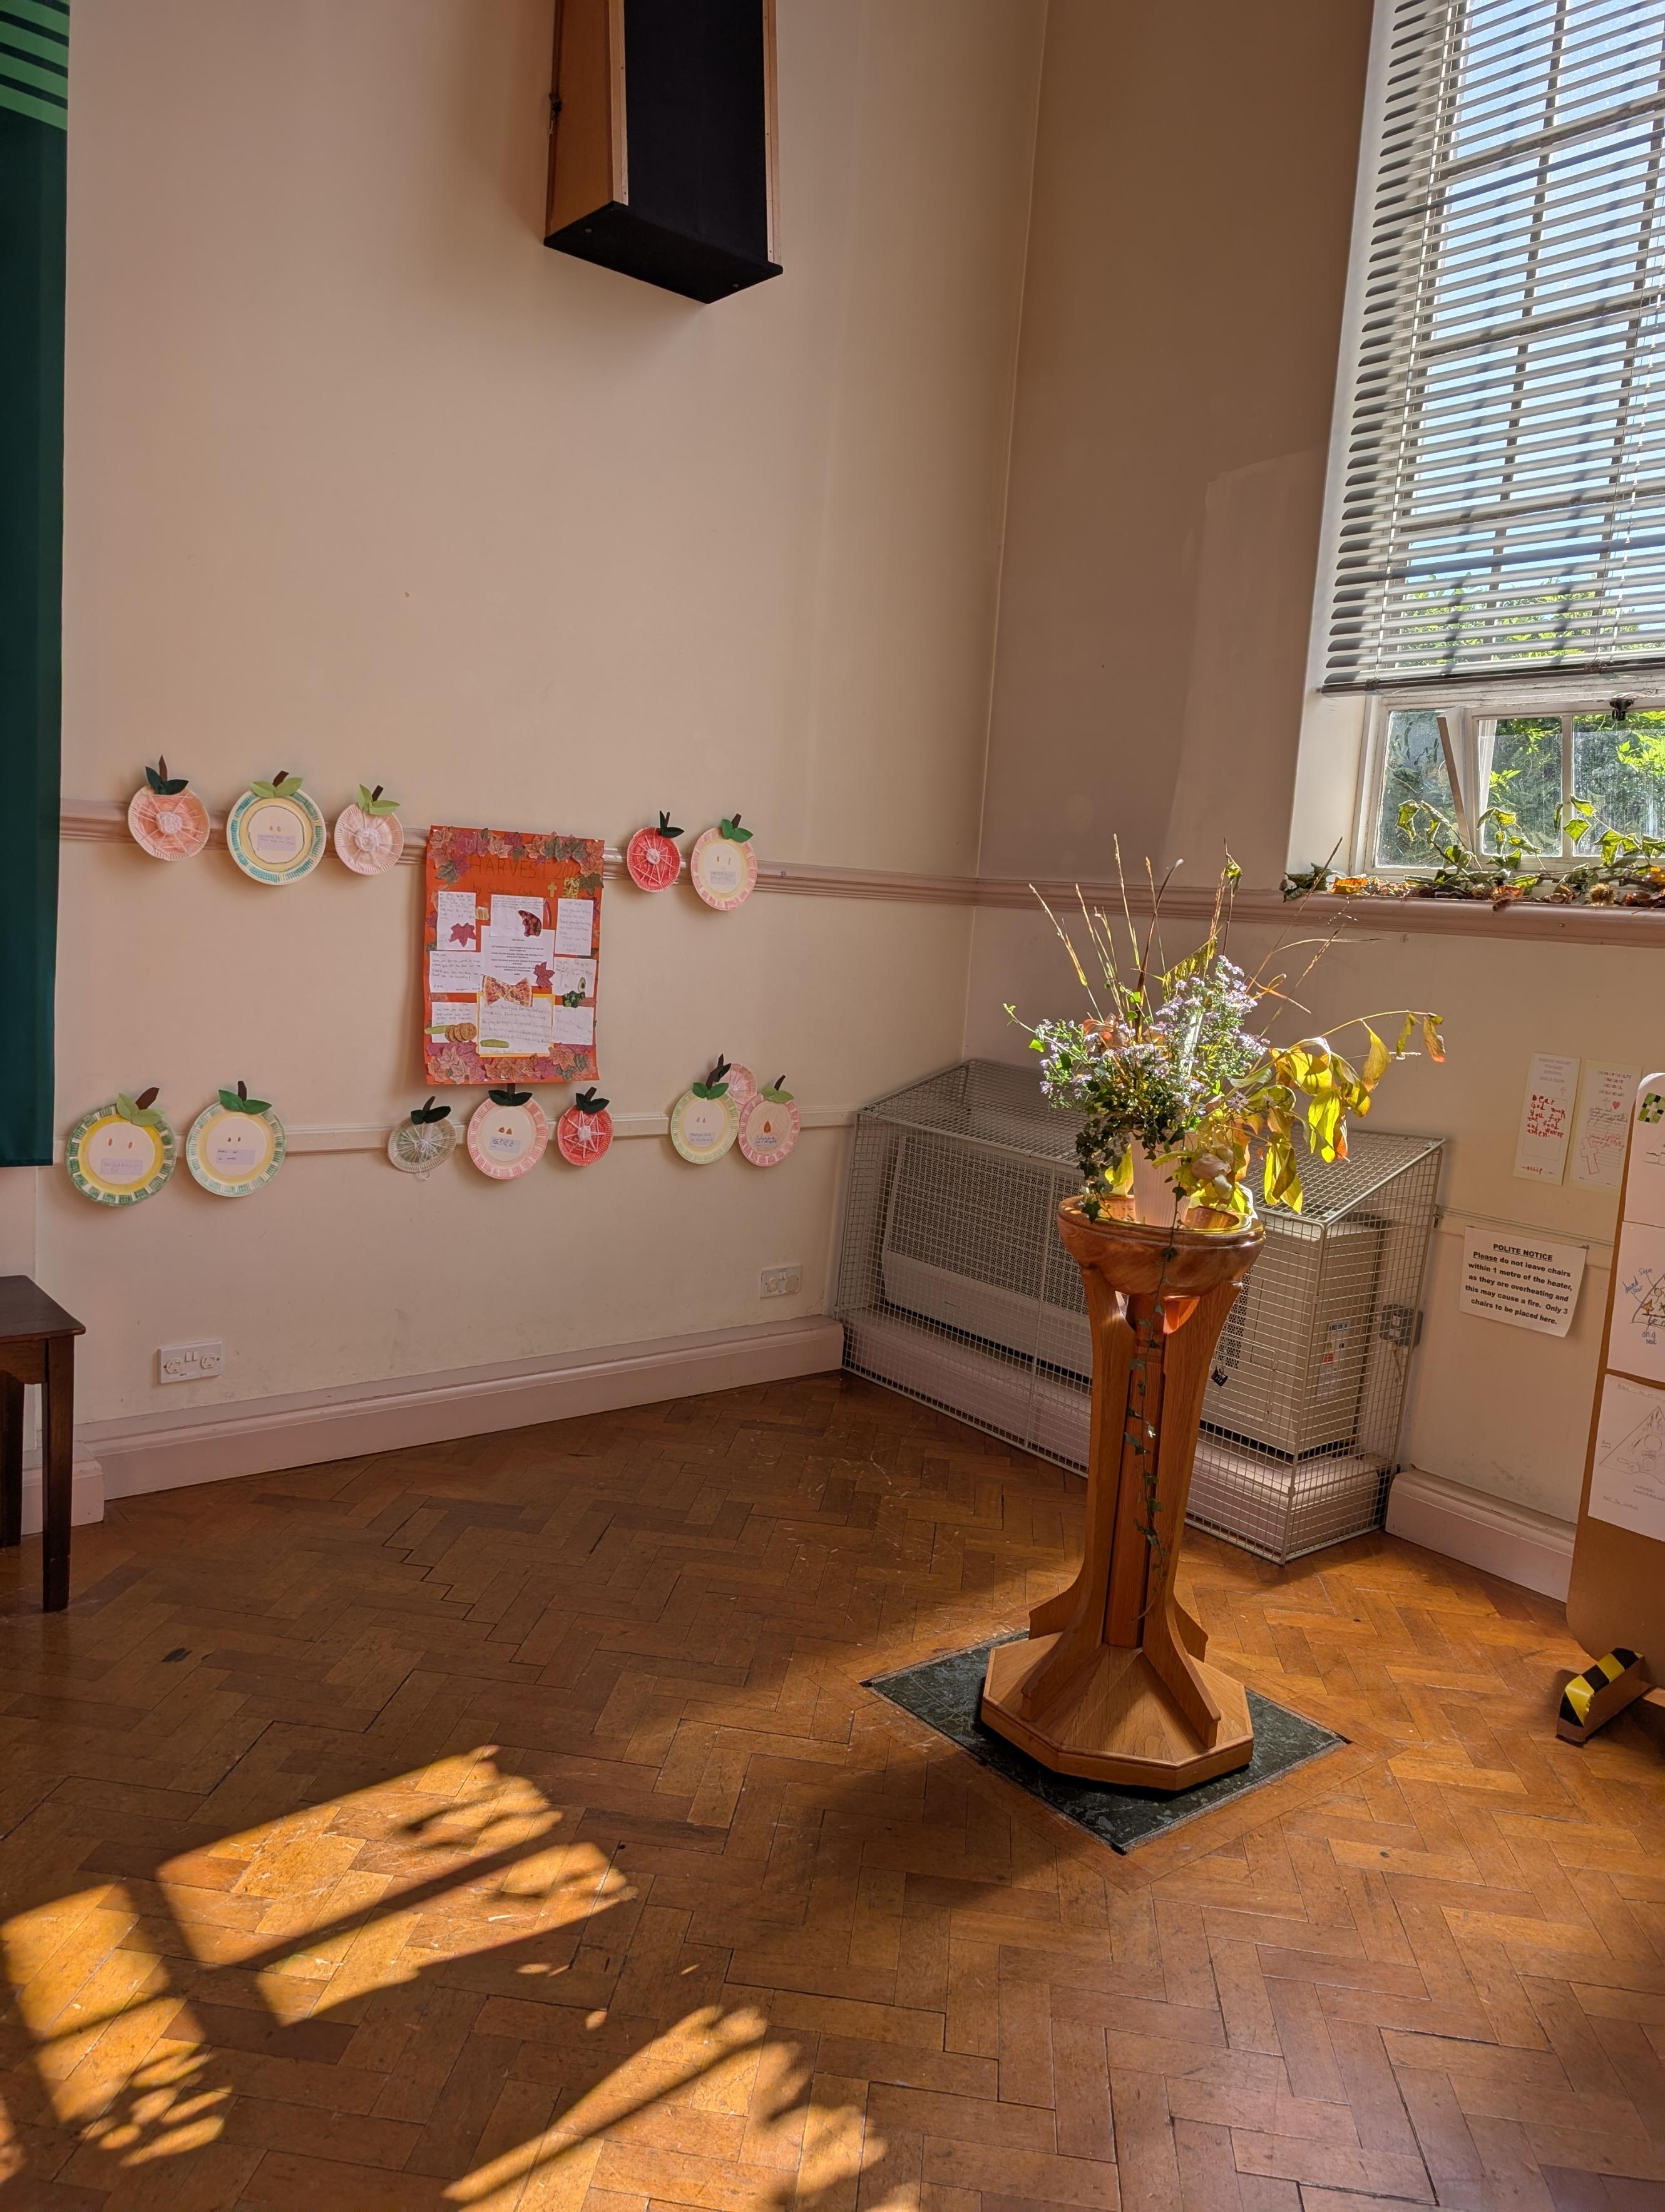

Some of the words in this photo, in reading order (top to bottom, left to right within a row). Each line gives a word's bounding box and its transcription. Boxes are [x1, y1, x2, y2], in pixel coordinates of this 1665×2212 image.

[469, 855, 551, 879] HARVEST
[1473, 1251, 1498, 1262] Please
[1525, 1262, 1545, 1272] leave
[1547, 1267, 1571, 1277] chairs
[1493, 1243, 1521, 1255] POLITE
[1523, 1249, 1553, 1261] NOTICE
[1468, 1262, 1490, 1272] within
[1499, 1269, 1521, 1278] metre
[1533, 1276, 1545, 1284] the
[1547, 1279, 1572, 1292] heater,
[1479, 1275, 1495, 1286] they
[1497, 1280, 1509, 1288] are
[1510, 1283, 1554, 1300] overheating
[1555, 1294, 1569, 1302] and
[1465, 1285, 1478, 1293] this
[1480, 1289, 1496, 1298] may
[1497, 1293, 1519, 1303] cause
[1527, 1298, 1542, 1308] fire.
[1545, 1304, 1562, 1314] Only
[1470, 1298, 1493, 1309] chairs
[1504, 1305, 1514, 1314] be
[1514, 1309, 1538, 1320] placed
[1539, 1314, 1557, 1325] here.
